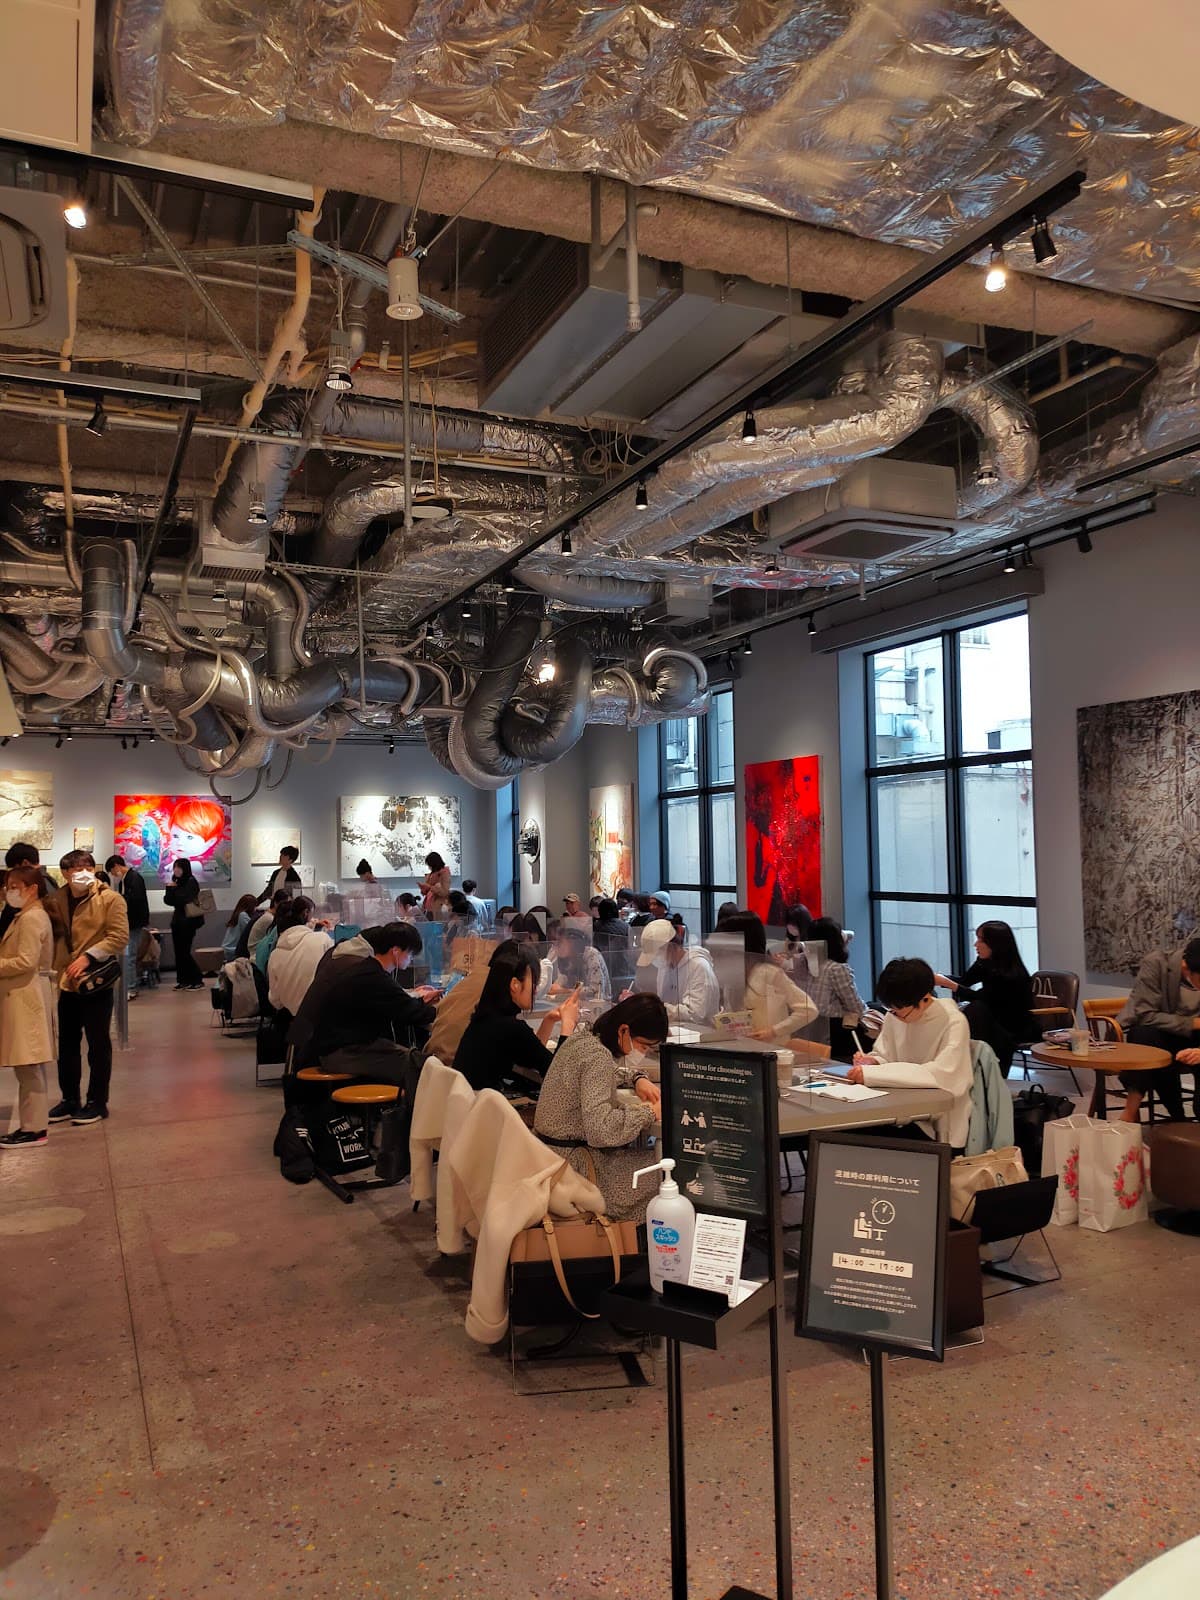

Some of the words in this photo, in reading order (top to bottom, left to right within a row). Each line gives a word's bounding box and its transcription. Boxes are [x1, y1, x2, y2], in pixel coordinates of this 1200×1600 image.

[677, 1061, 696, 1070] Thank
[696, 1064, 708, 1072] you
[708, 1064, 717, 1073] for
